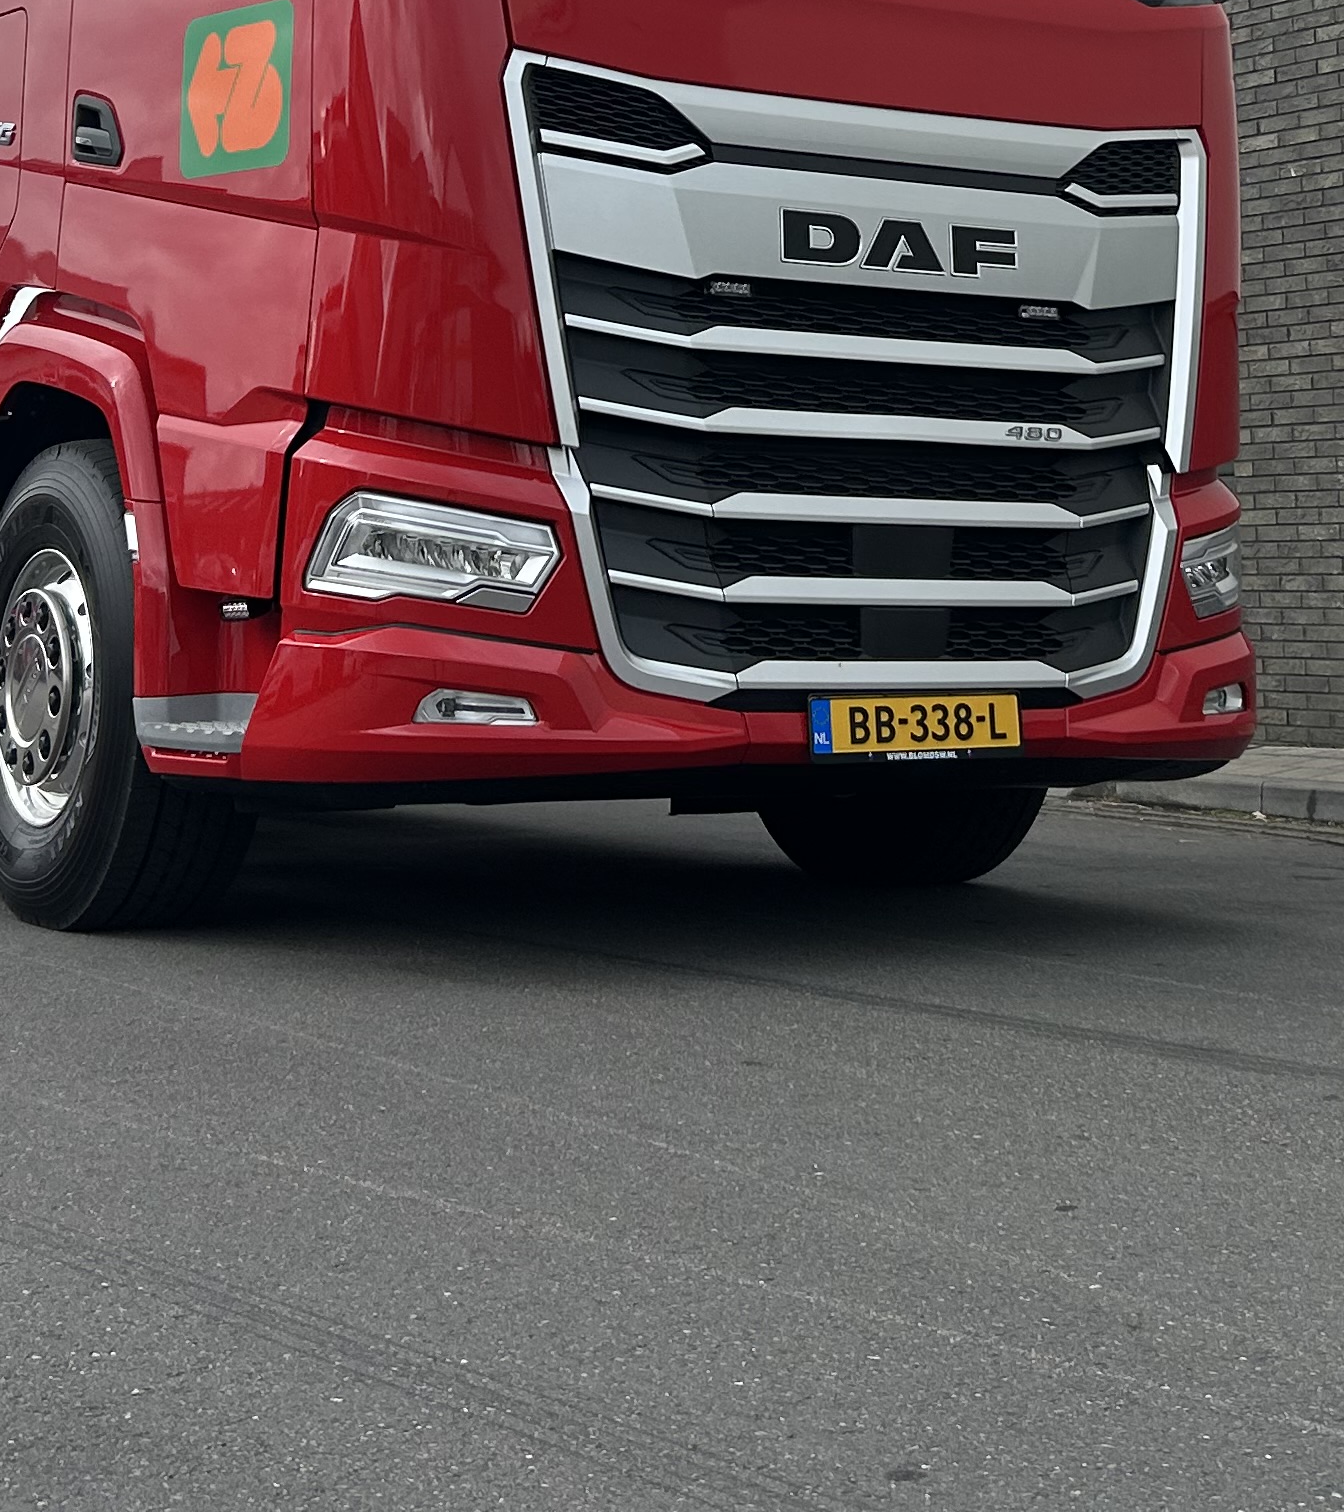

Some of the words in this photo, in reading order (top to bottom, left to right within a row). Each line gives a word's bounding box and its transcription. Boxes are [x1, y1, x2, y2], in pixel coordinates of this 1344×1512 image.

[778, 206, 1019, 279] DAF
[1005, 425, 1063, 442] 480
[813, 731, 831, 746] NL
[848, 702, 1008, 745] BB-338-L
